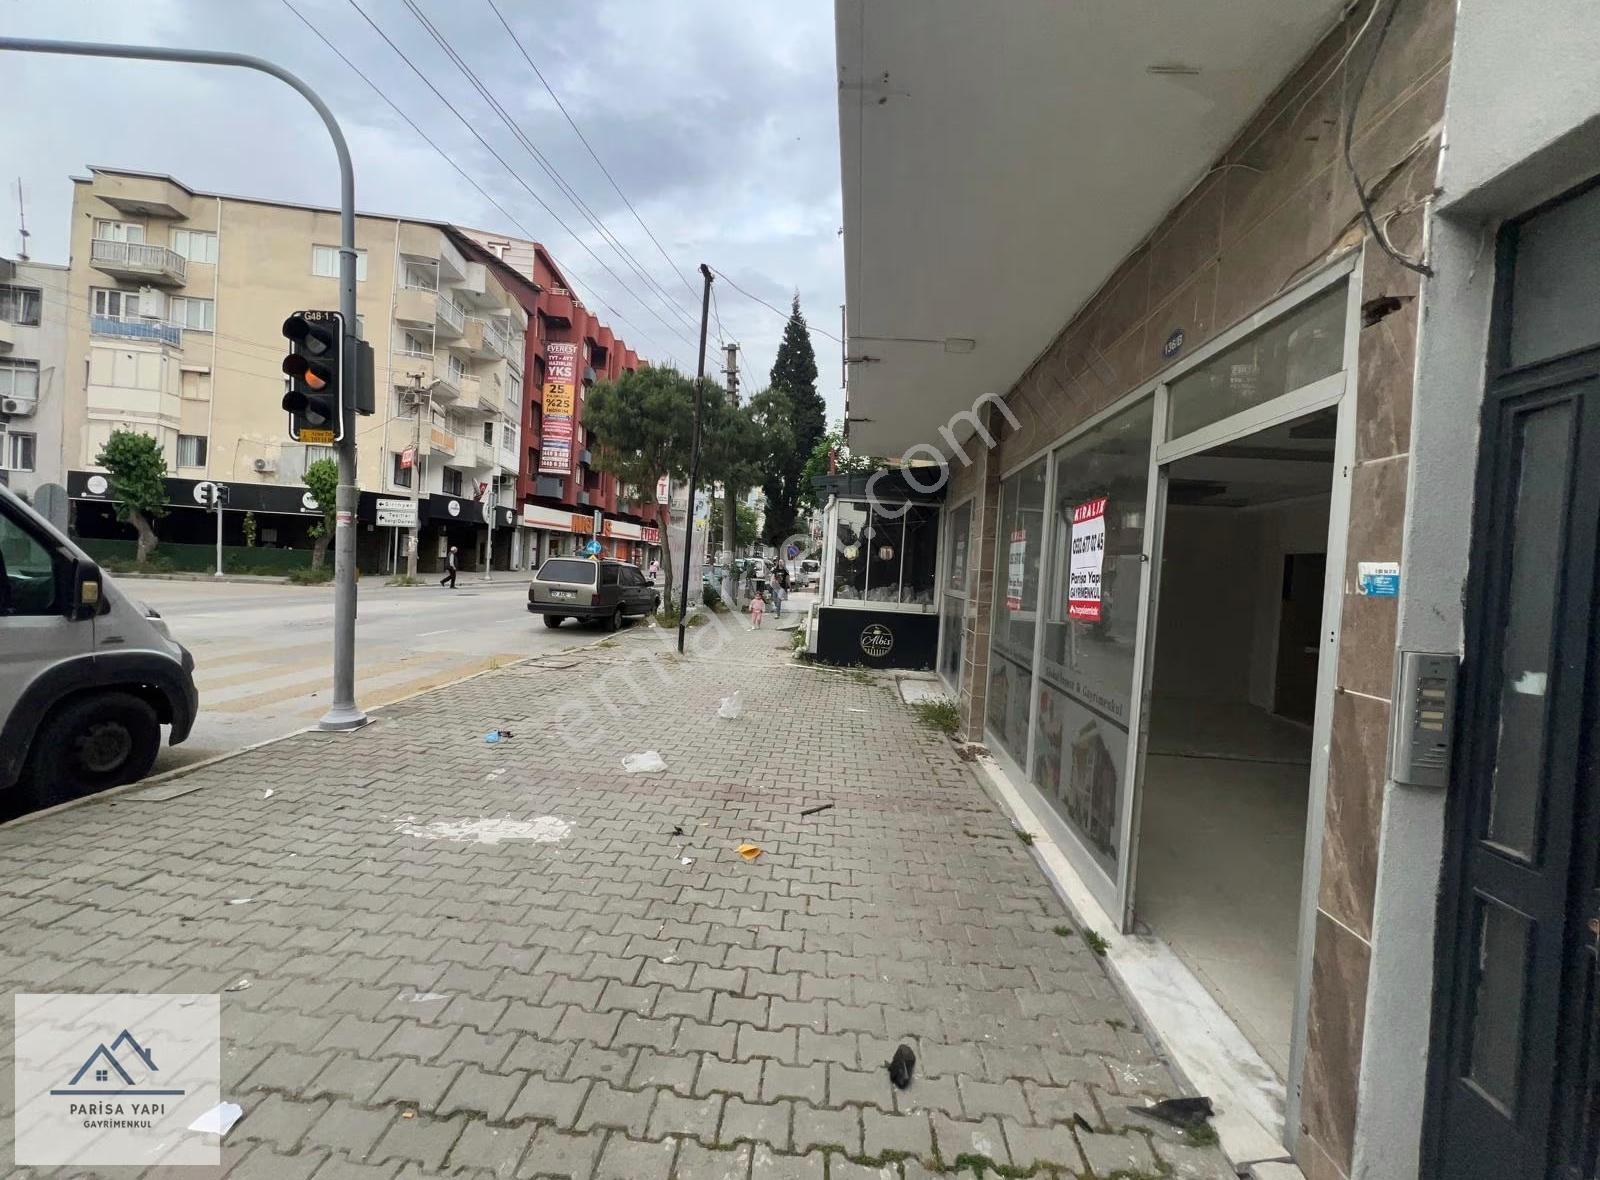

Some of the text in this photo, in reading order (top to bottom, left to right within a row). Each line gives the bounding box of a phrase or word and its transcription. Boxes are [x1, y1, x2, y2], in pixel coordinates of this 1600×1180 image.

[304, 312, 329, 320] G48-1
[547, 344, 578, 353] EVEREST
[548, 366, 572, 377] YKS
[546, 398, 570, 408] %25
[1070, 571, 1086, 585] Parisa
[862, 635, 890, 646] Albis
